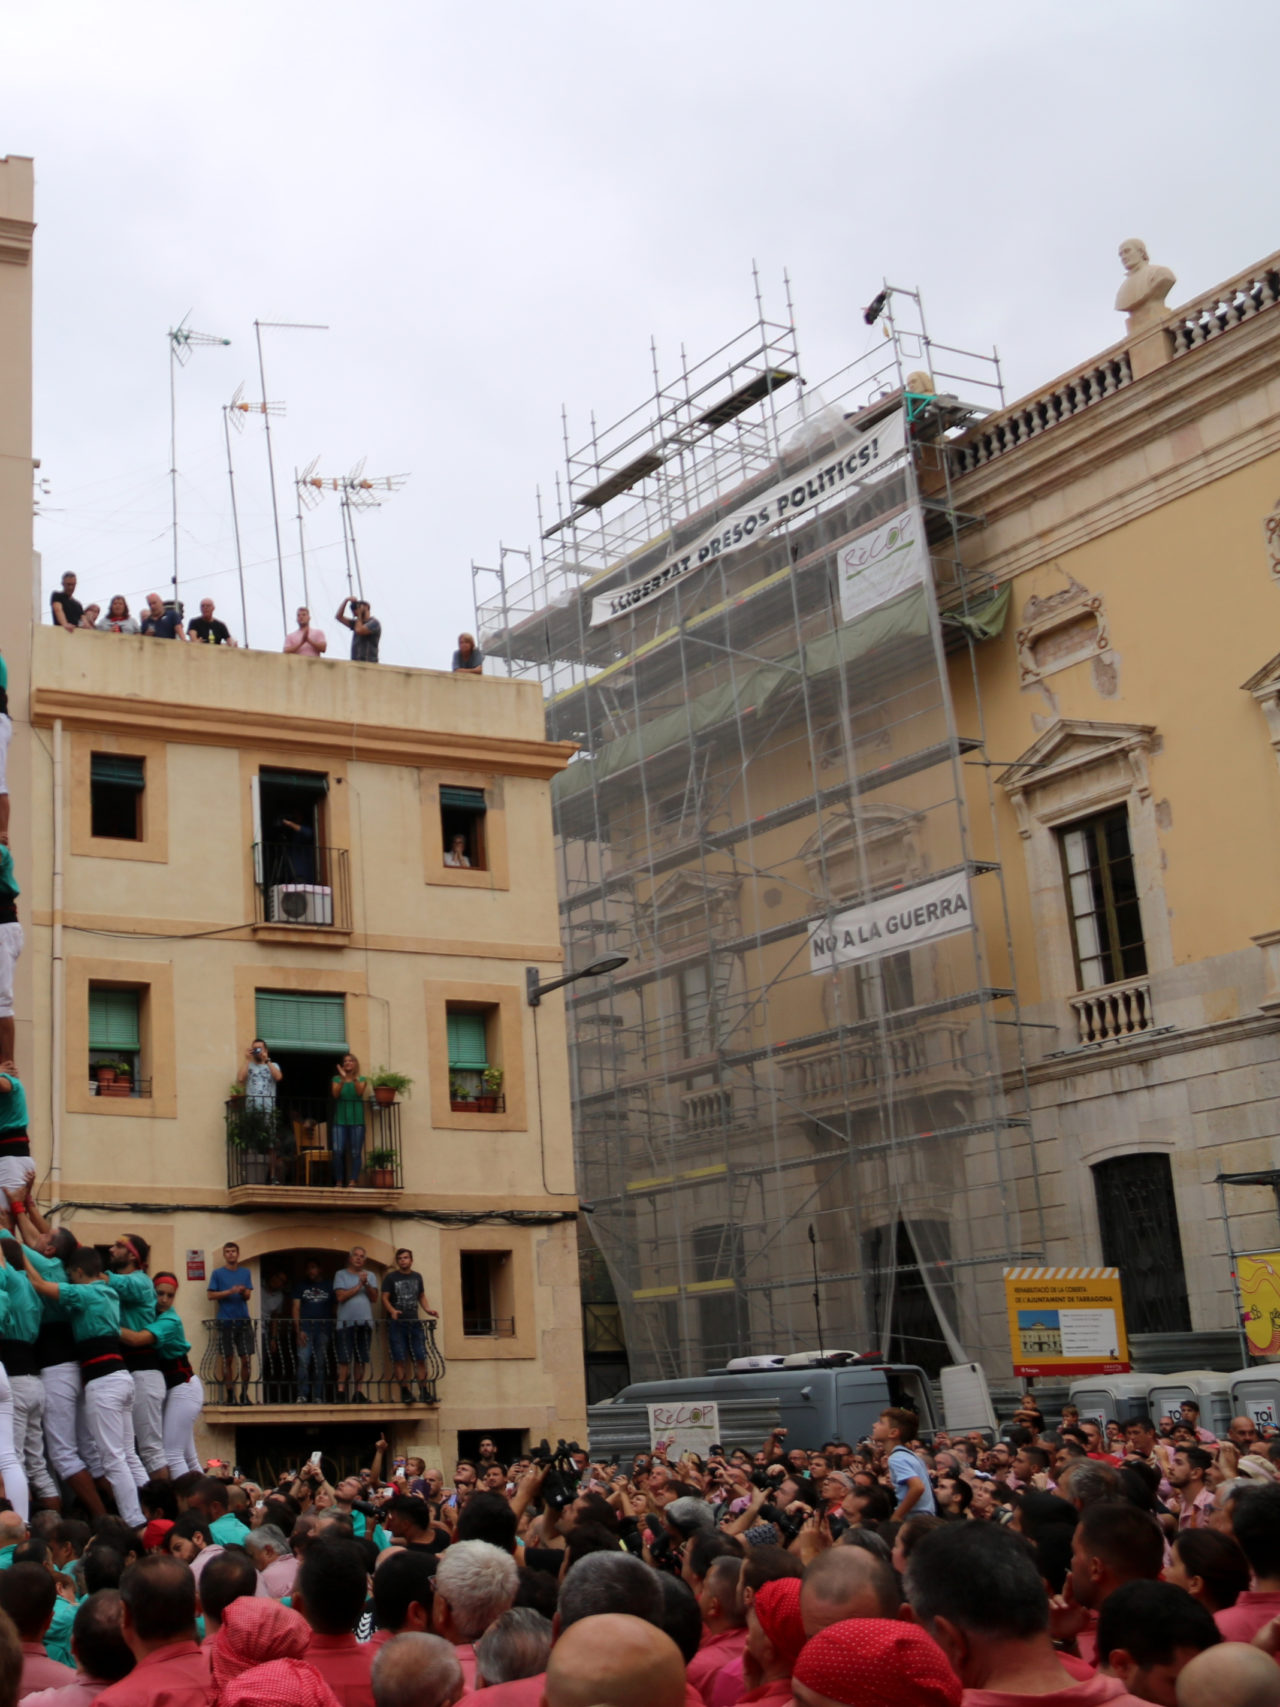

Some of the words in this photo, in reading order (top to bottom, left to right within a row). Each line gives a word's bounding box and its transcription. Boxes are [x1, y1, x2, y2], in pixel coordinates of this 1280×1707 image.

[610, 556, 691, 615] LLIBERTAT
[698, 507, 770, 562] PRESOS
[812, 935, 837, 957] NO
[843, 930, 855, 948] A
[858, 922, 882, 943] LA
[885, 893, 968, 935] GUERRA
